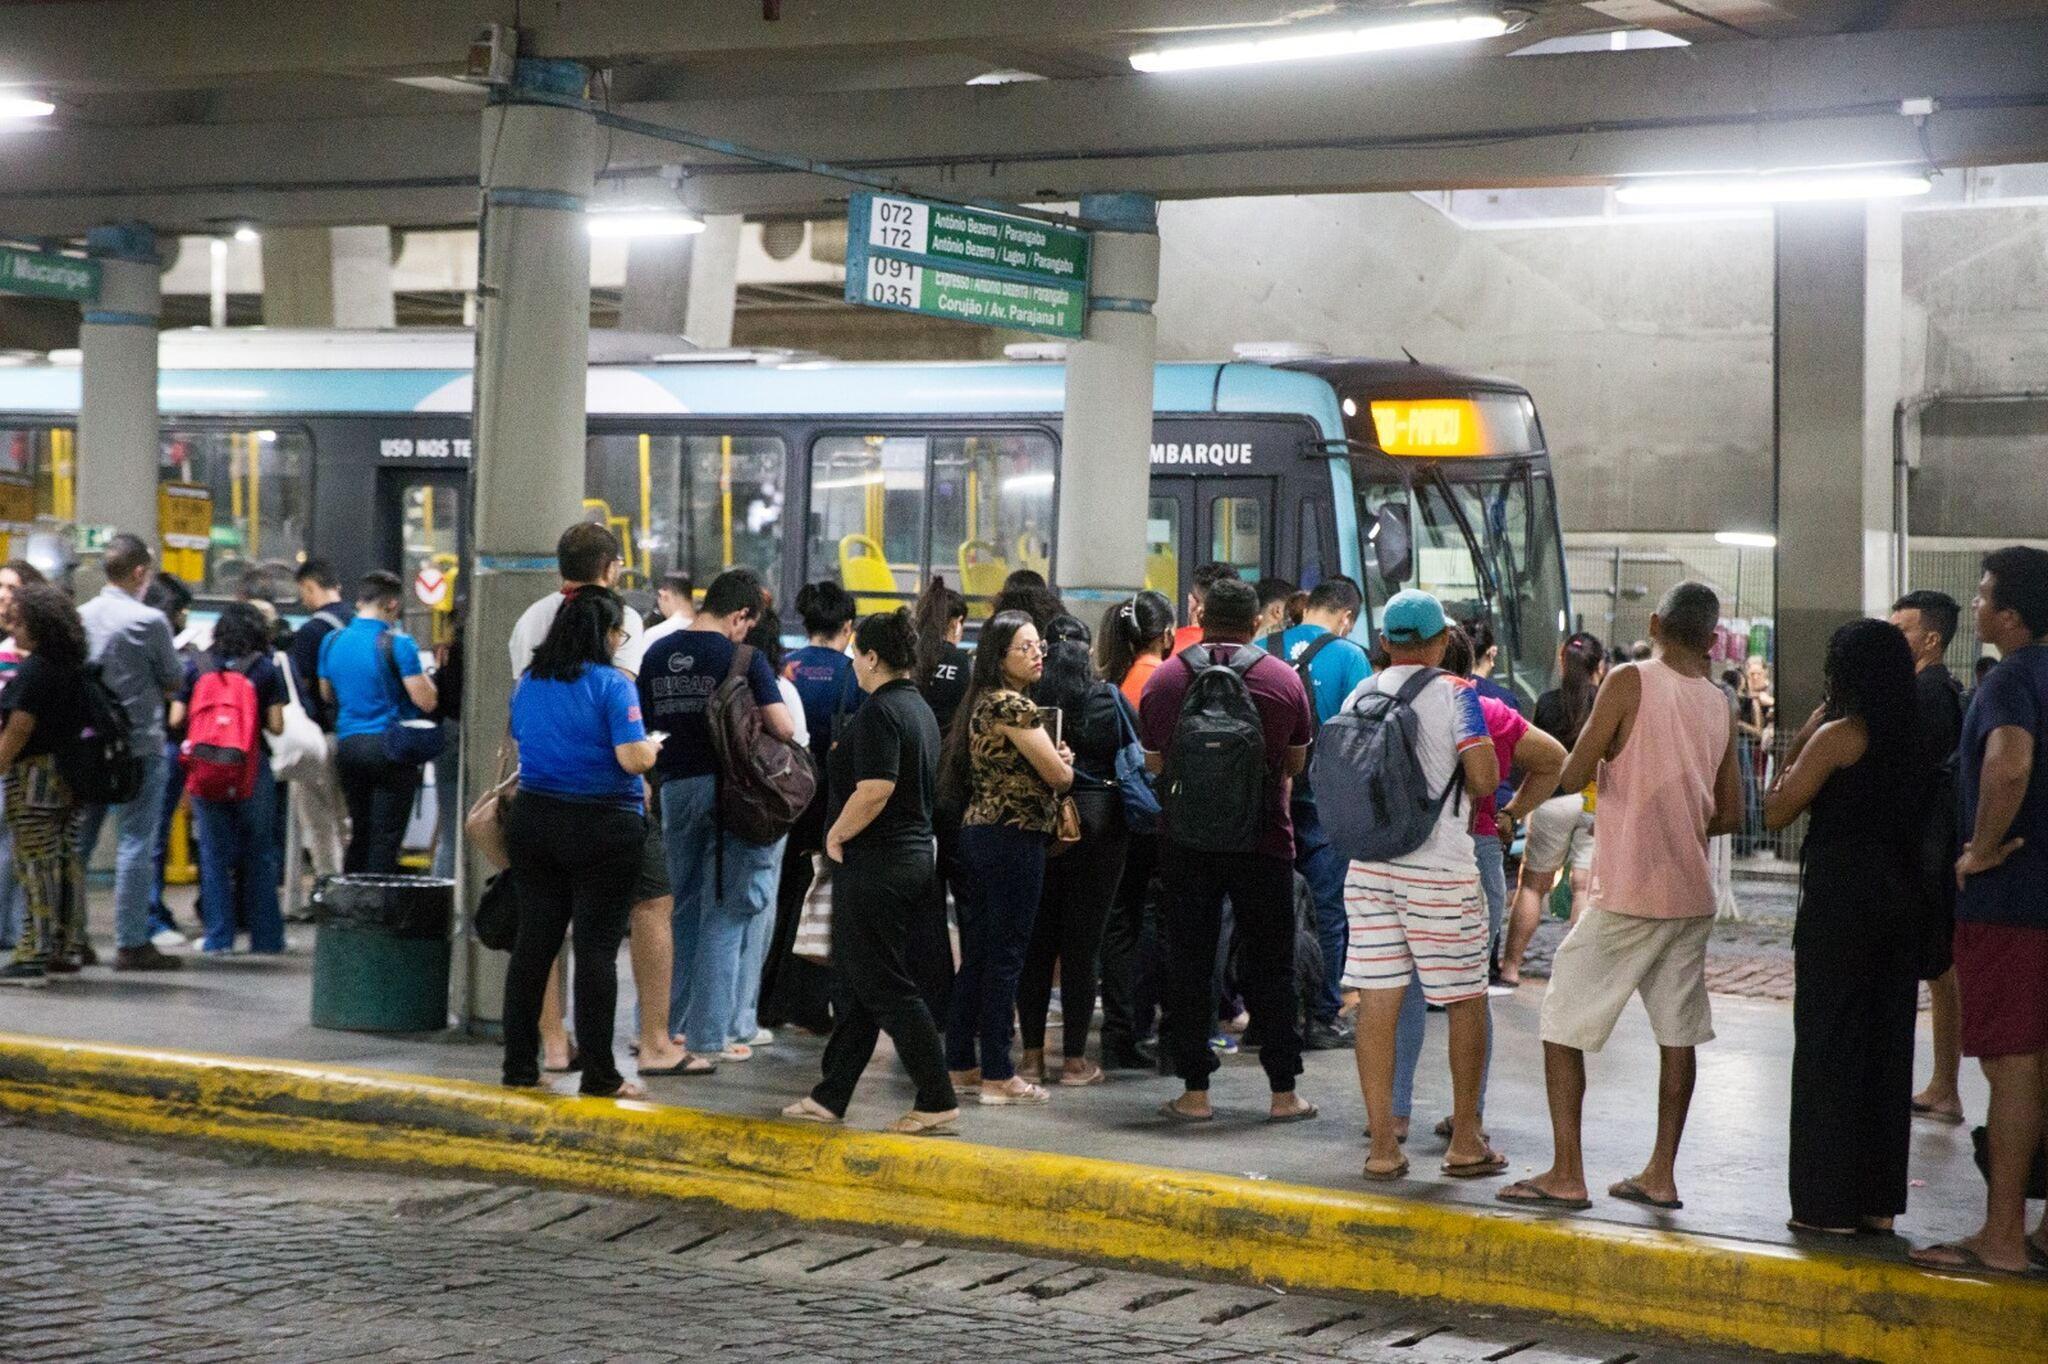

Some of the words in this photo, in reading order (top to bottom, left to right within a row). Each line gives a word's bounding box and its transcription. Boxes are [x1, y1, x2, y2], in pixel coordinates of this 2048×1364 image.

[881, 203, 913, 226] 072
[881, 227, 912, 248] 172
[934, 212, 967, 232] Antônio
[967, 218, 998, 238] Bezerra
[1005, 224, 1047, 247] Parangaba
[874, 256, 915, 281] 091
[873, 283, 913, 308] 035
[938, 294, 983, 316] Corujão
[990, 302, 1007, 319] Av.
[1009, 304, 1055, 326] Parajana
[380, 438, 415, 458] USO
[415, 438, 450, 458] NOS
[1150, 443, 1253, 466] MBARQUE
